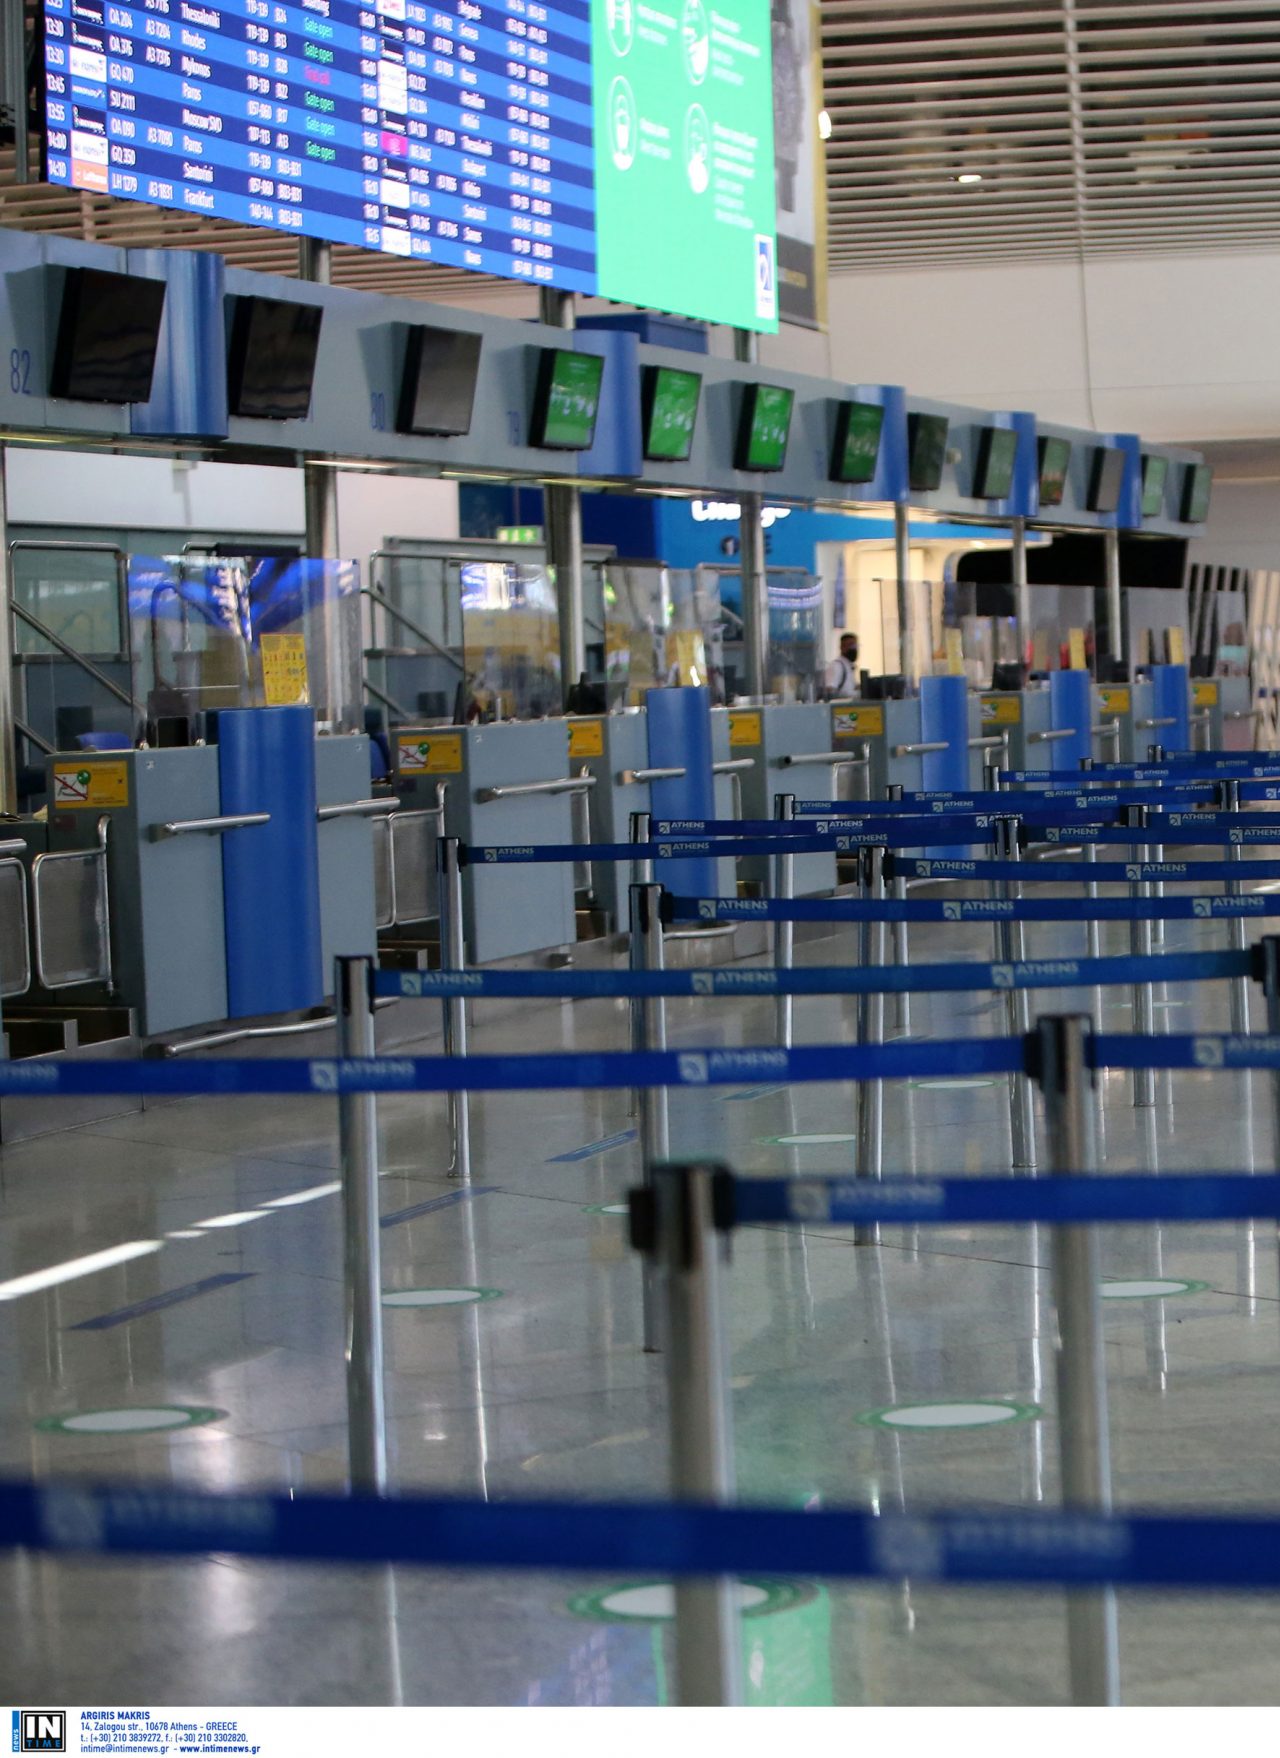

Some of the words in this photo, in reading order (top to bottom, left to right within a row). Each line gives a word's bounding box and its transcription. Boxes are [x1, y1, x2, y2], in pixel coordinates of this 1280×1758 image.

[181, 2, 220, 29] Thessaloniki
[181, 29, 207, 50] Rhodes
[110, 90, 121, 107] SU
[112, 173, 122, 189] LH
[184, 188, 214, 209] Frankfurt
[10, 349, 31, 394] 82
[1060, 828, 1098, 836] ATHENS
[498, 847, 534, 855] ATHENS
[672, 842, 709, 850] ATHENS
[932, 861, 976, 871] ATHENS
[1143, 864, 1187, 873] ATHENS
[718, 900, 768, 911] ATHENS
[962, 902, 1014, 912] ATHENS
[1213, 897, 1265, 908] ATHENS
[1015, 962, 1079, 975] ATHENS
[423, 973, 483, 985] ATHENS
[715, 972, 777, 984] ATHENS
[709, 1052, 788, 1067] ATHENS
